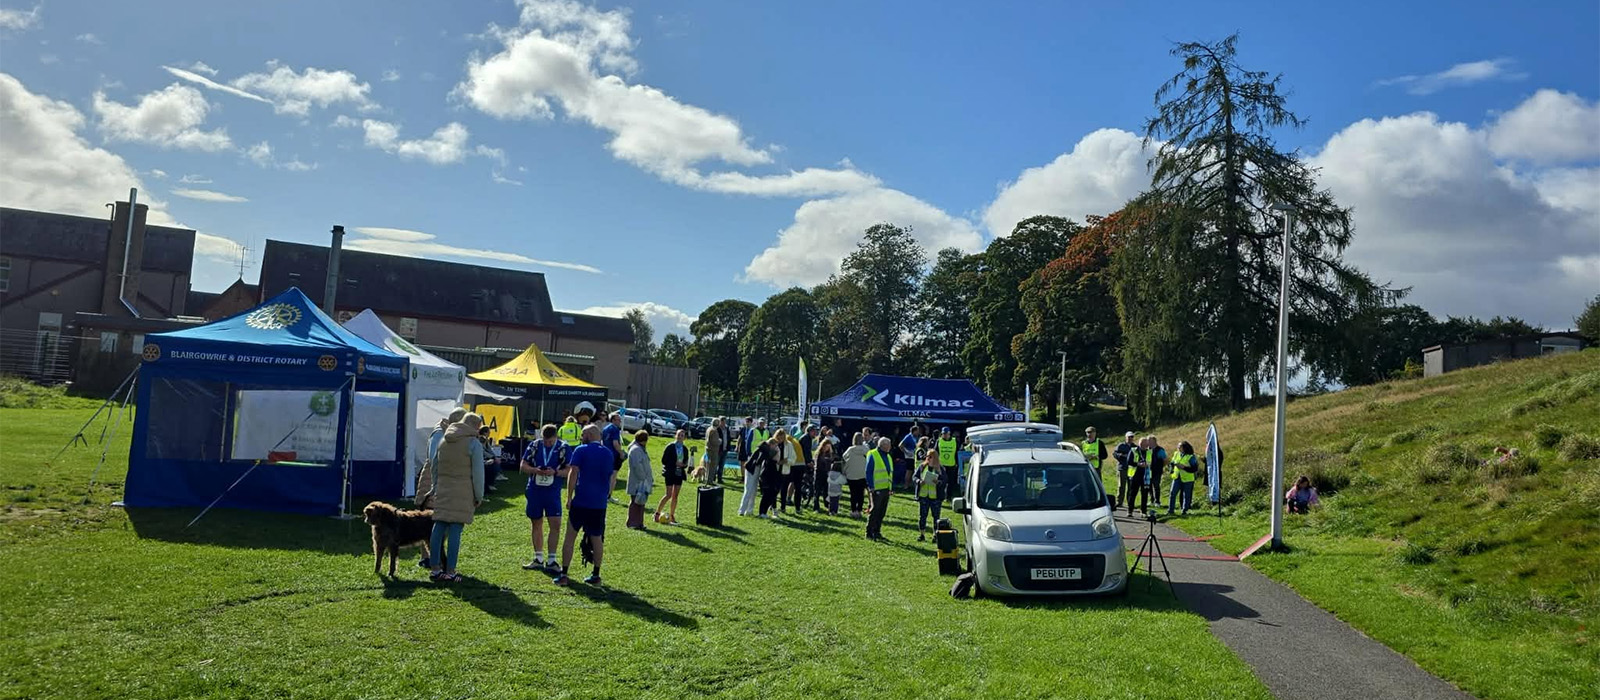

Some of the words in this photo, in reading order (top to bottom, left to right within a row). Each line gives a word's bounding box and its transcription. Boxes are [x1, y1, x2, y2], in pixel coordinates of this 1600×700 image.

[170, 350, 227, 361] BLAIRGOWRIE
[237, 355, 273, 364] DISTRICT
[275, 357, 308, 365] ROTARY
[894, 393, 974, 408] Kilmac
[898, 409, 931, 418] KILMAC
[1036, 569, 1056, 578] PE61
[1058, 569, 1076, 578] UTP
